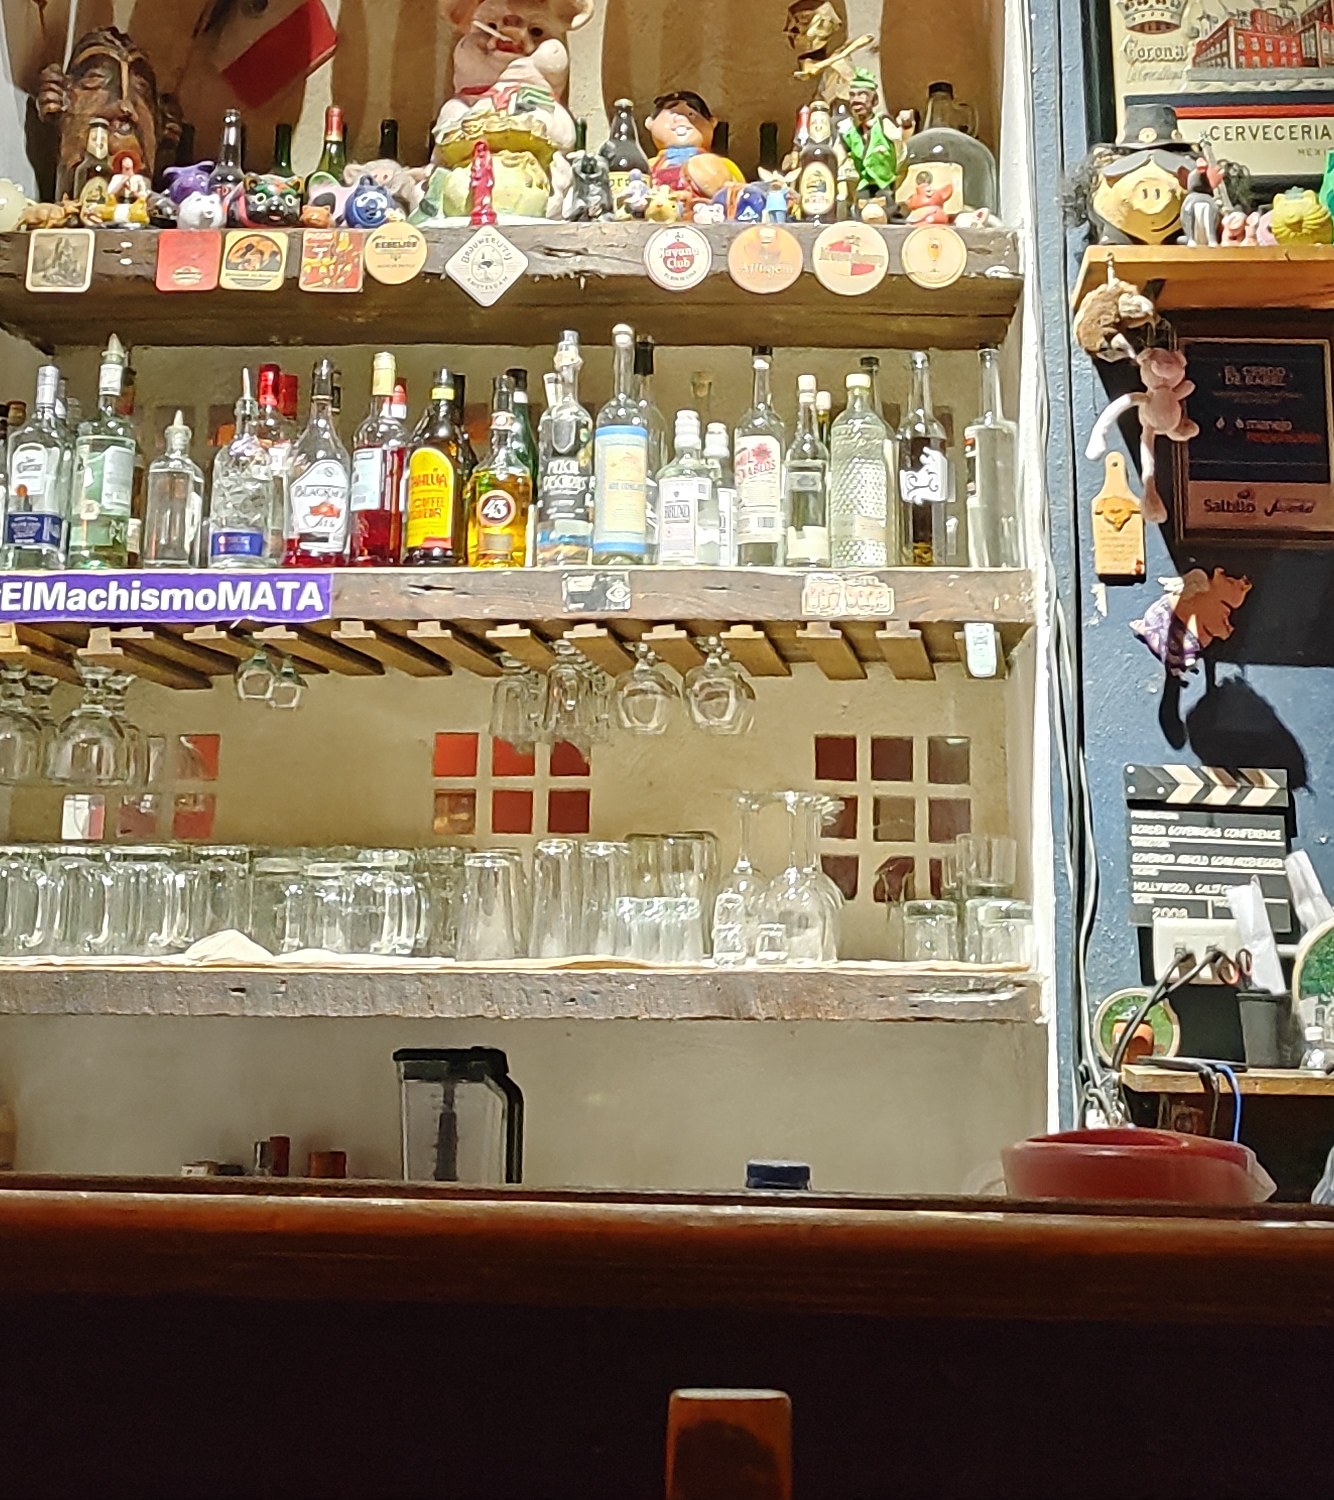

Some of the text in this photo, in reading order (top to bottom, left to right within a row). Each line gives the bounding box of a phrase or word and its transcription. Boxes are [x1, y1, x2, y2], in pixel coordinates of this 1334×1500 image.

[1120, 35, 1189, 67] Corona
[1209, 122, 1332, 143] CERVECERIA
[658, 246, 700, 261] Havana
[665, 256, 691, 269] Club
[481, 499, 508, 520] 43
